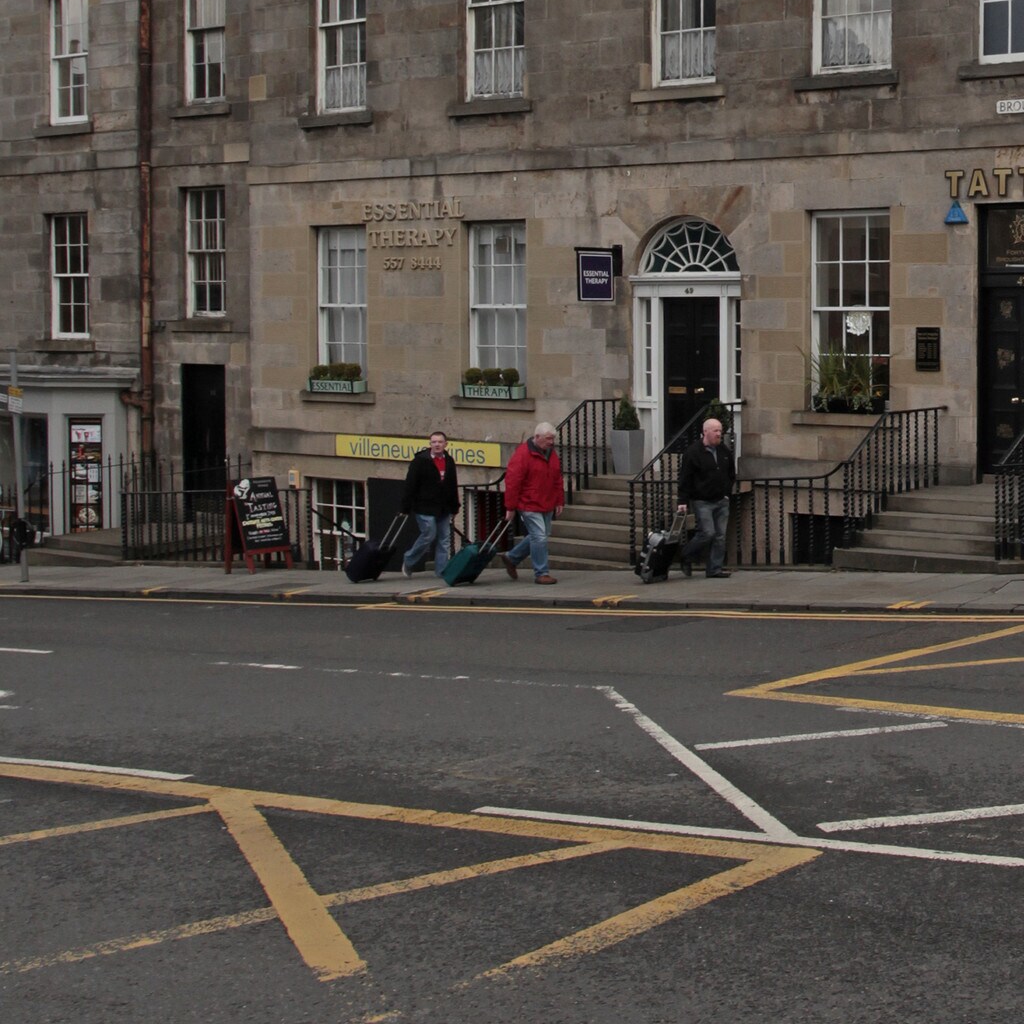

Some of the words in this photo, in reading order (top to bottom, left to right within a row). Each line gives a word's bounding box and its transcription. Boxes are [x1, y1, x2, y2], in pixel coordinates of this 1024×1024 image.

[361, 196, 465, 222] ESSENTIAL
[369, 227, 457, 248] THERAPY
[383, 257, 405, 270] 557
[410, 257, 442, 270] 8444
[311, 381, 352, 392] ESSENTIAL
[467, 386, 510, 397] THERAPY
[448, 443, 486, 464] ines
